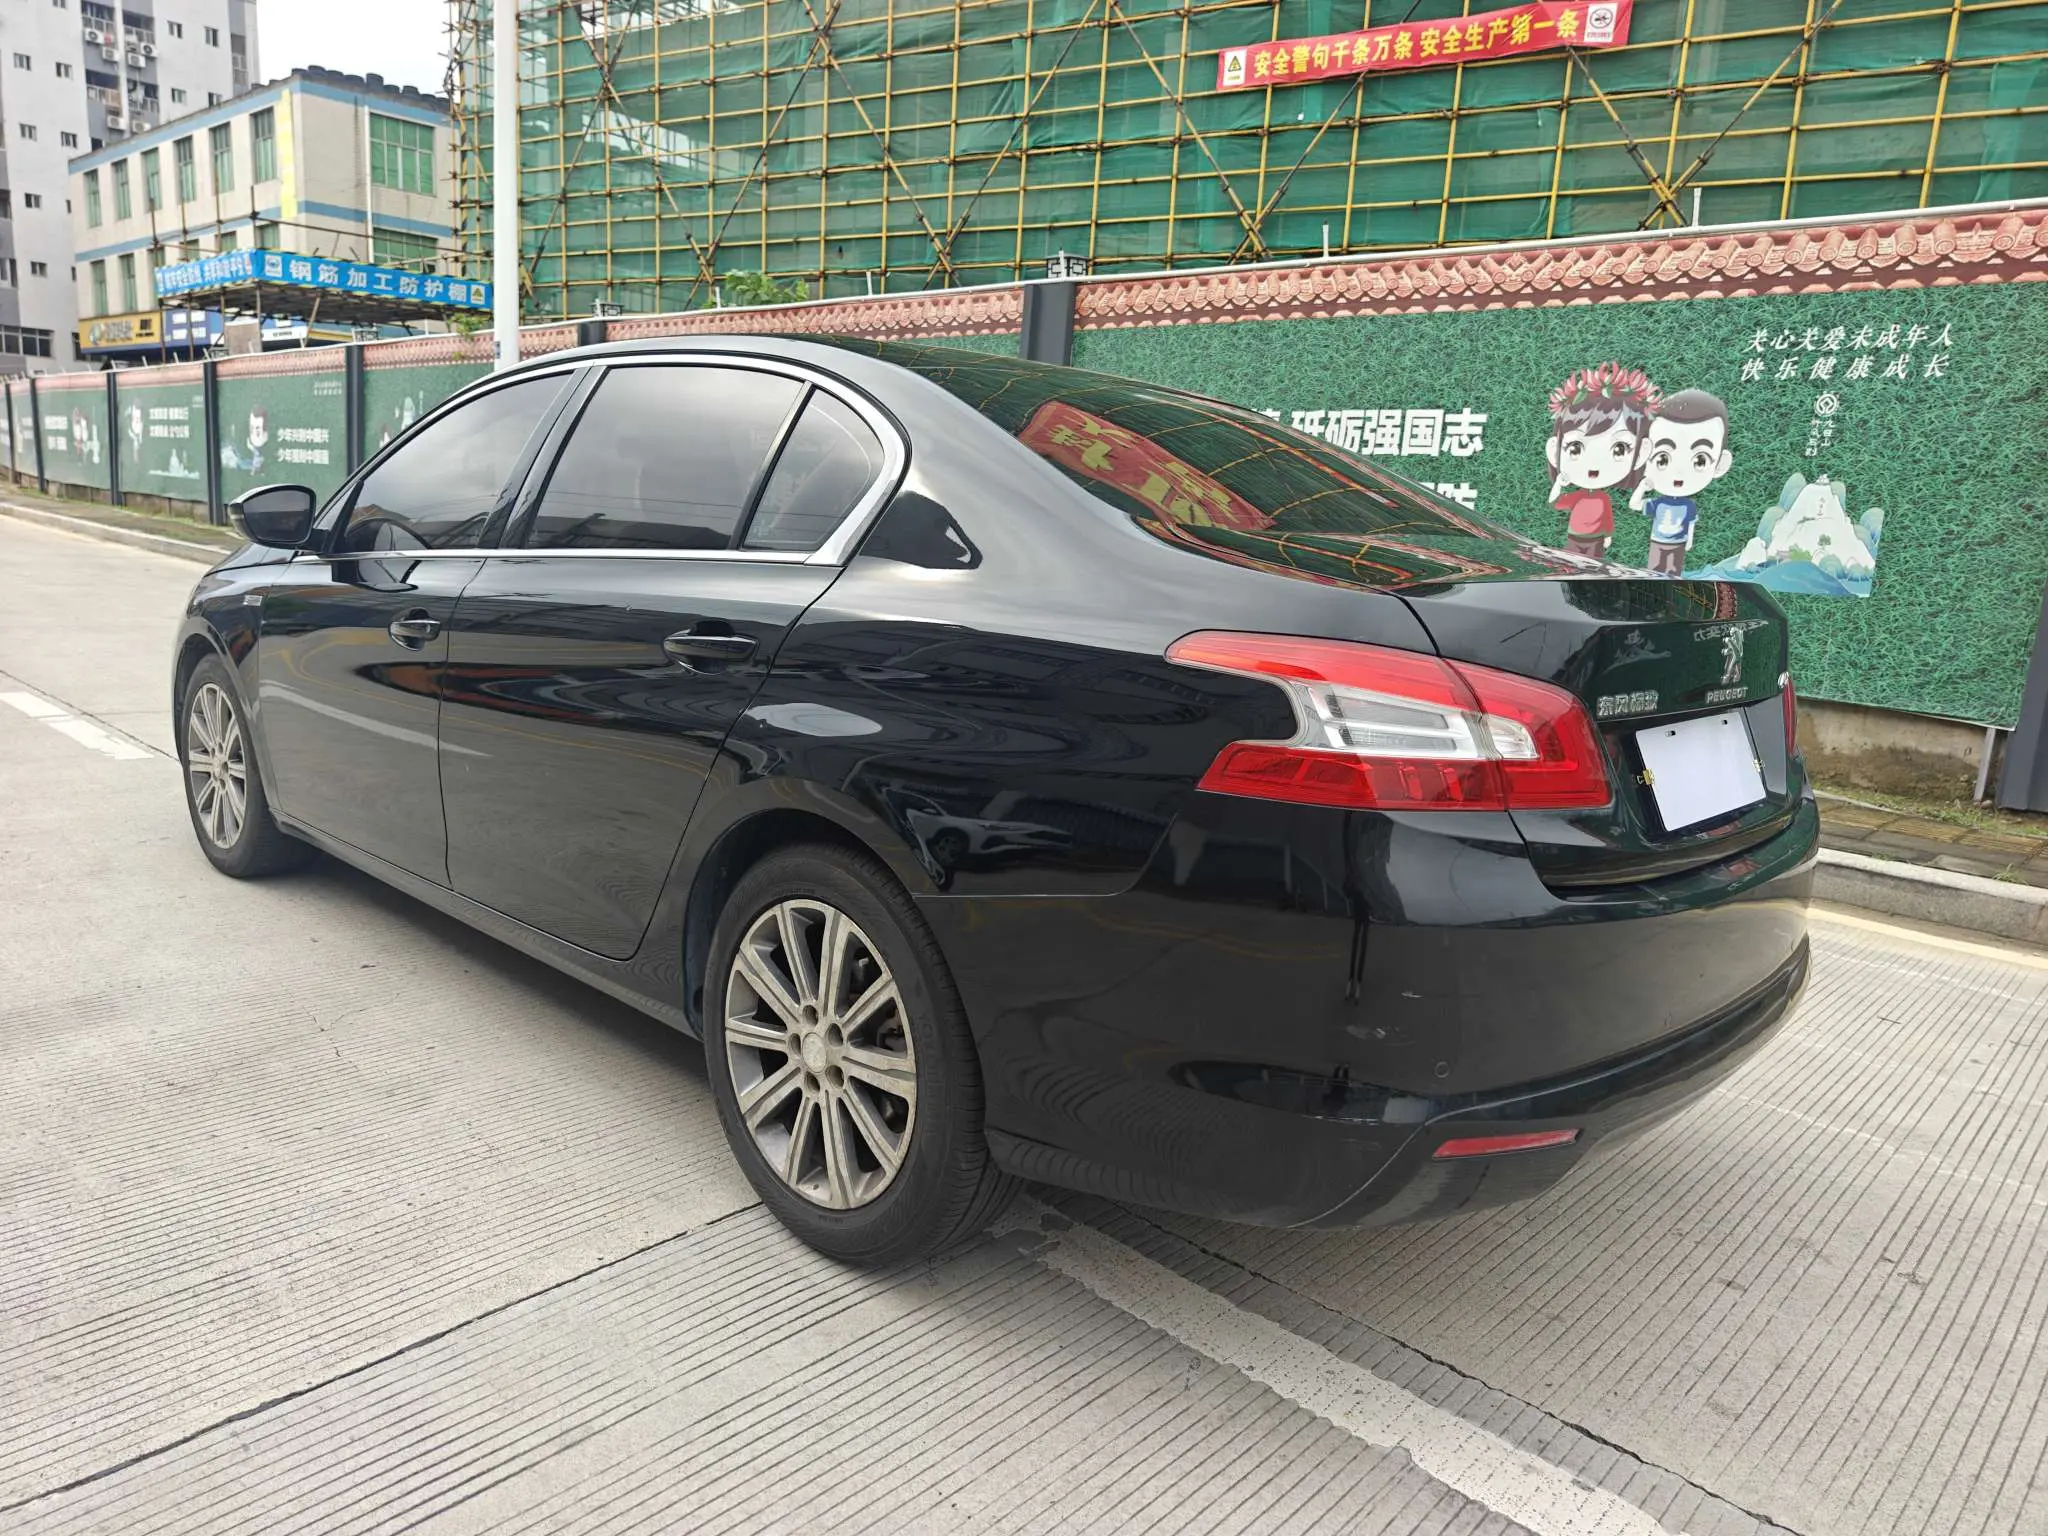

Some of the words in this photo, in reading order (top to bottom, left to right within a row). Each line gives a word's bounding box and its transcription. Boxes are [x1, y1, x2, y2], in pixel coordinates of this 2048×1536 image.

[1253, 31, 1413, 78] 安全警句千条万条
[1420, 10, 1579, 58] 安全生产第一条
[289, 259, 467, 302] 钢筋加工防护棚
[1741, 323, 1954, 353] 关心关爱未成年人
[1740, 354, 1950, 381] 快乐健康成长
[1706, 687, 1748, 704] PEUGEOT
